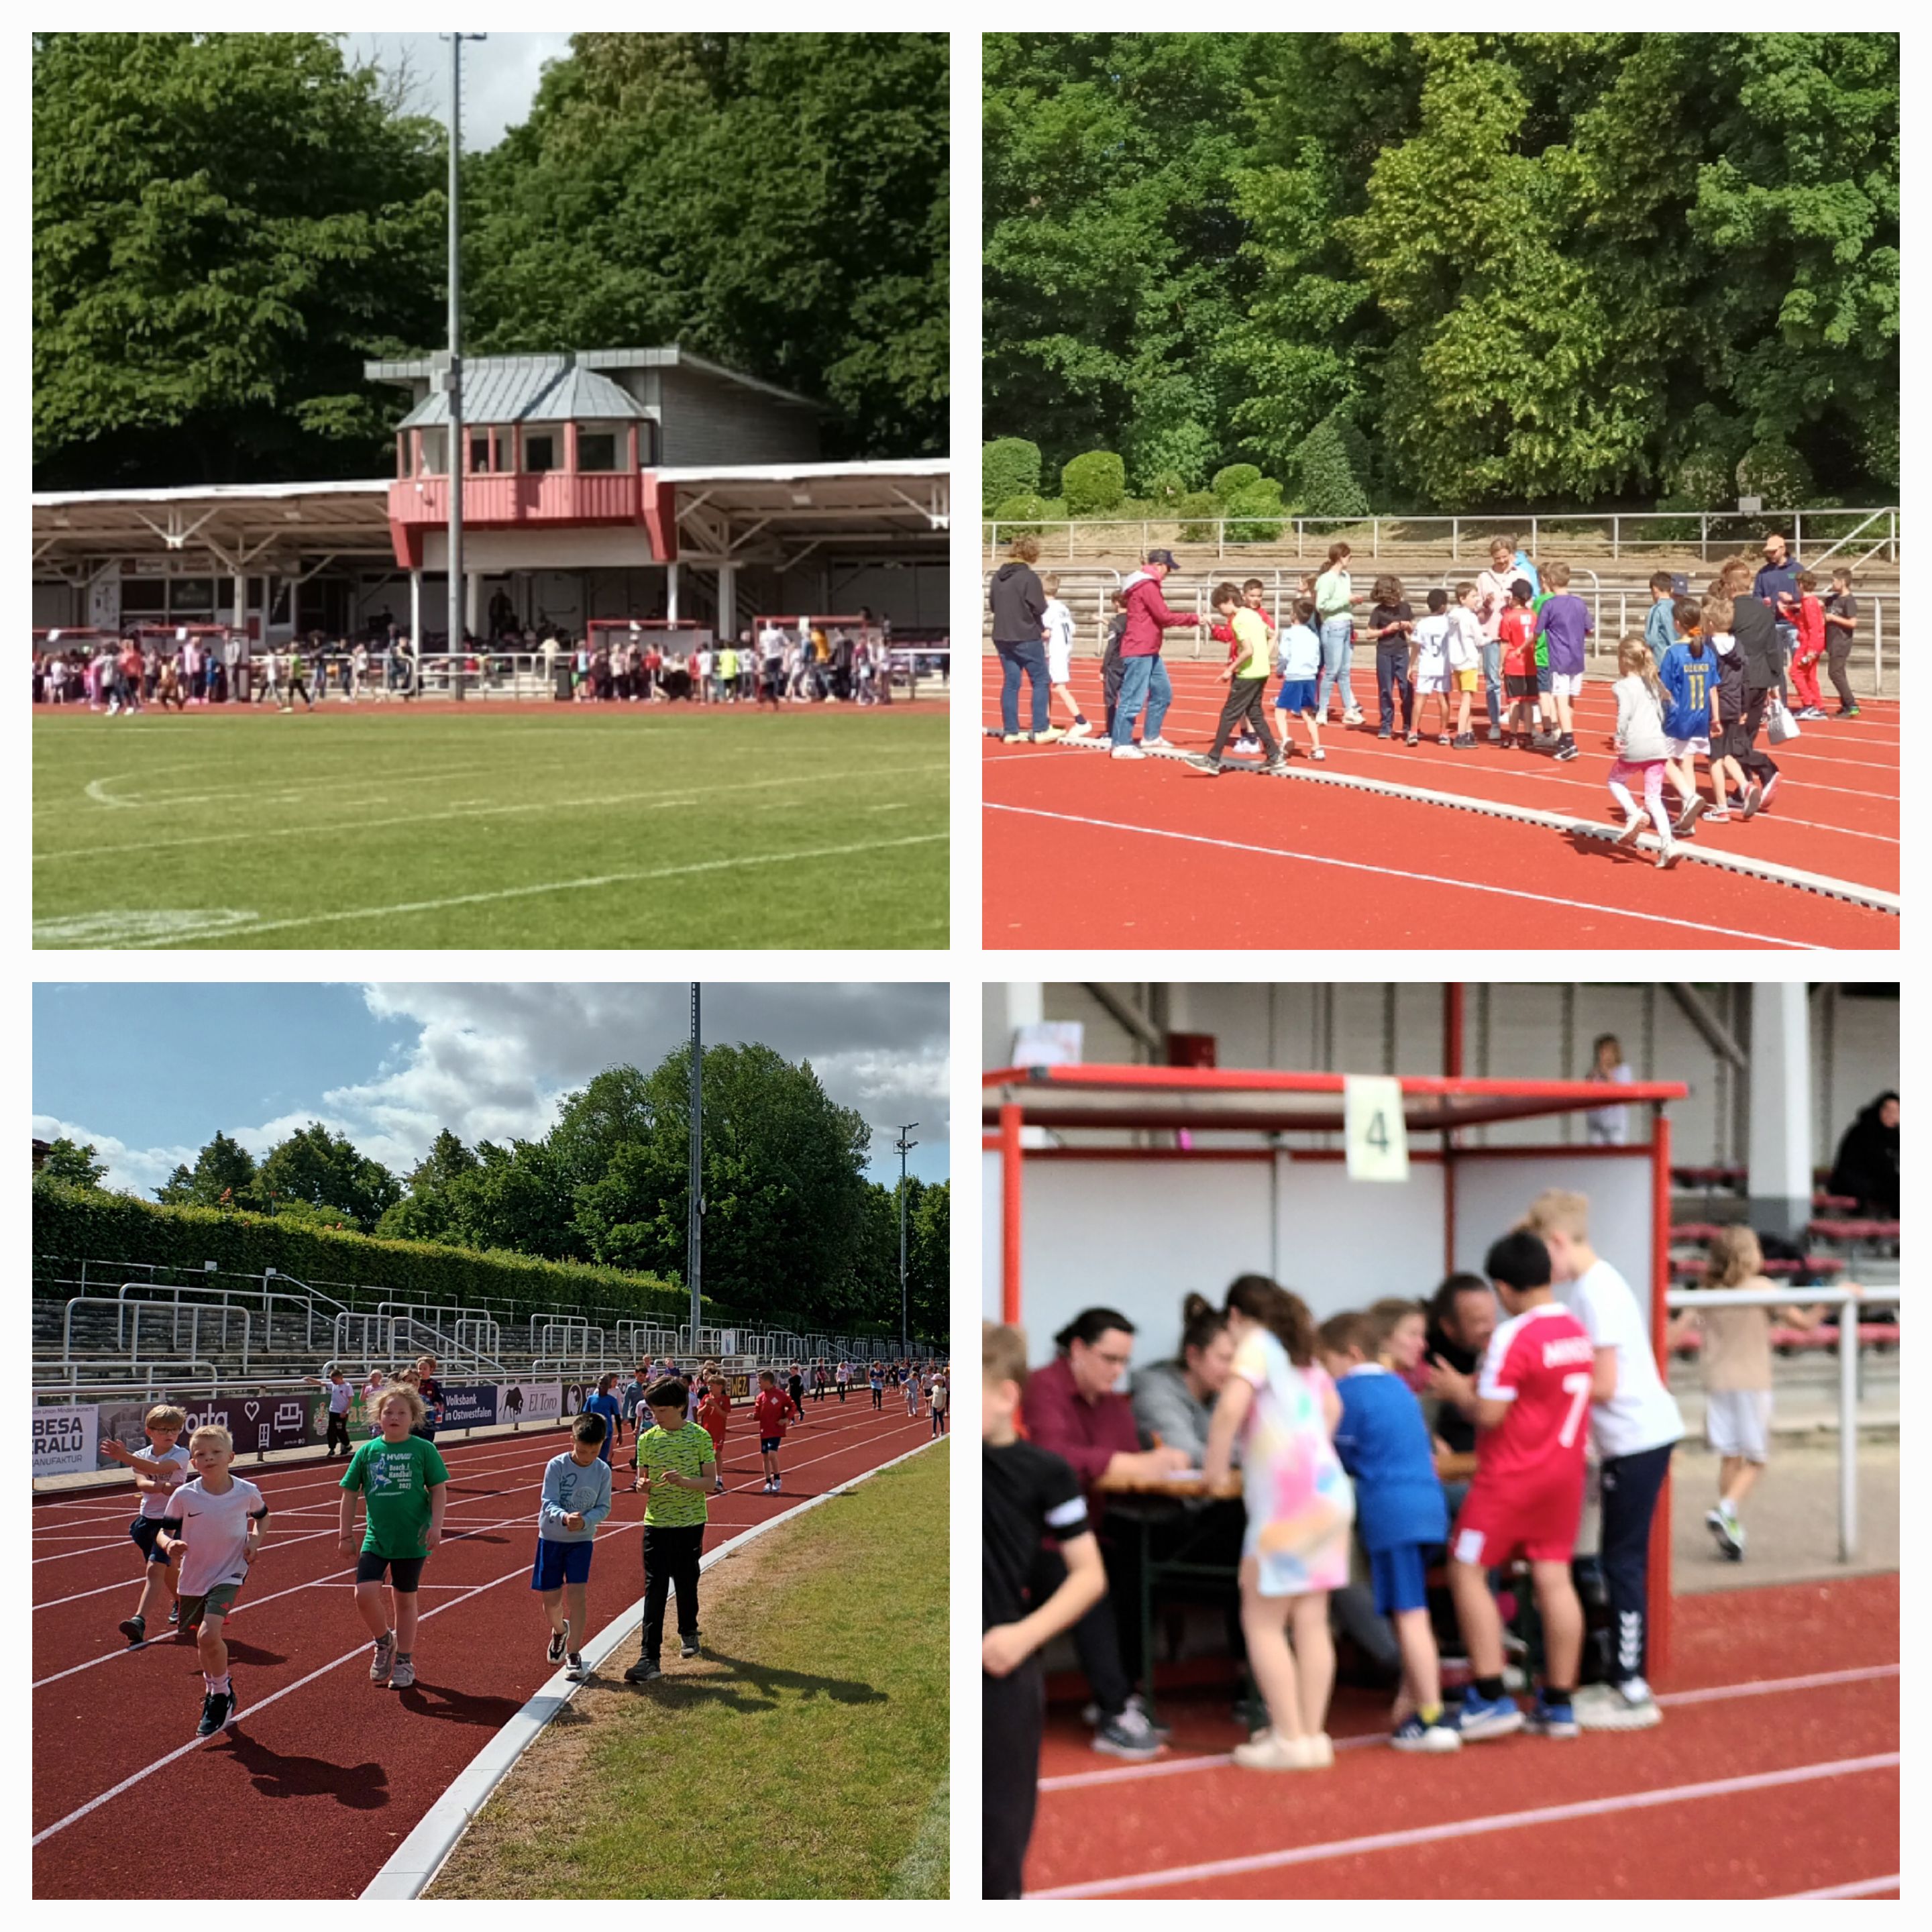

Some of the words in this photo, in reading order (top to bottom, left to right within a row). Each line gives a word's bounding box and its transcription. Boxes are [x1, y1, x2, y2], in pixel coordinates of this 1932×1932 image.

[1430, 633, 1442, 658] 5
[1688, 674, 1705, 709] 11
[1364, 1110, 1390, 1155] 4
[731, 1375, 749, 1396] WEZ
[445, 1393, 478, 1407] Volksbank
[528, 1393, 539, 1412] El
[539, 1393, 558, 1411] Toro
[1558, 1372, 1590, 1448] 7
[178, 1403, 229, 1435] orta
[445, 1409, 452, 1421] in
[452, 1406, 493, 1421] Ostwestfalen
[32, 1417, 83, 1436] BESA
[32, 1435, 83, 1455] RALU
